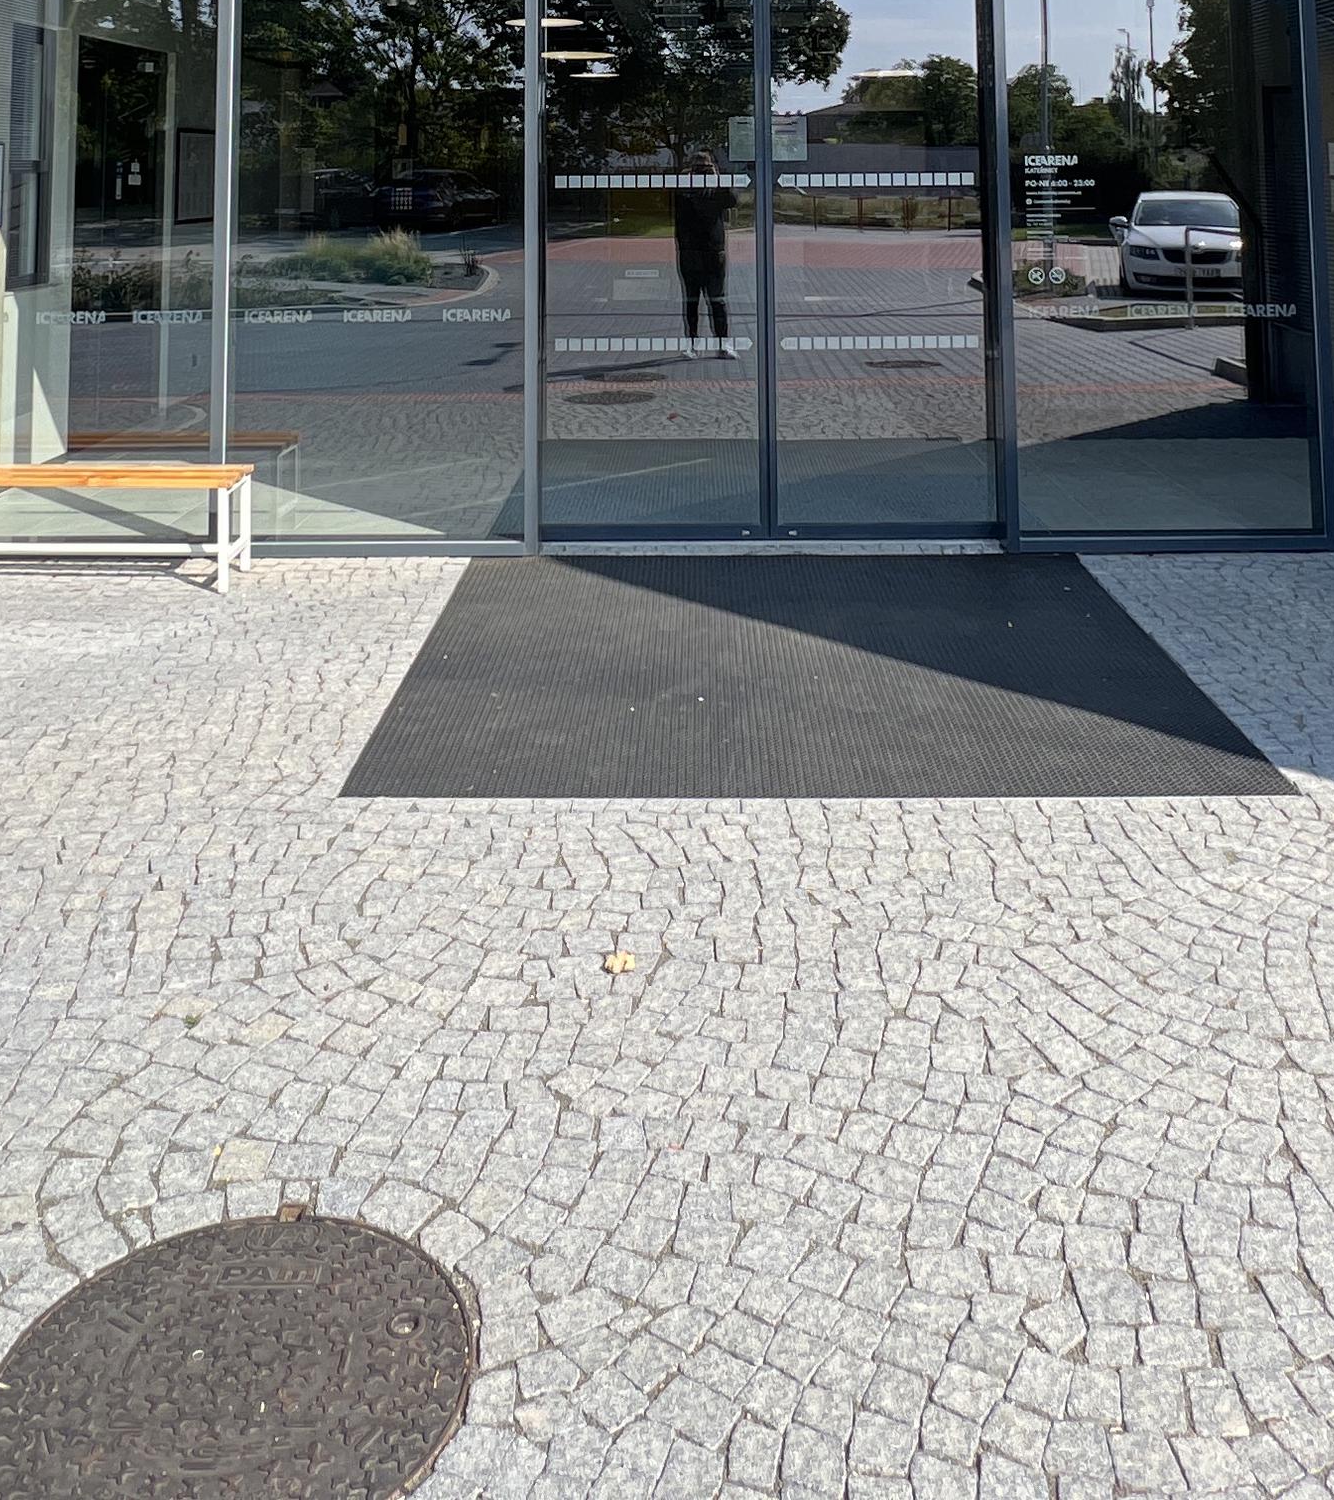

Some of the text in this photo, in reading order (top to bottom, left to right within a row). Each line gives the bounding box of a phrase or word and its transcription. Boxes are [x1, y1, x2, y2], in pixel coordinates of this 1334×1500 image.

[1024, 155, 1079, 166] ICEARENA
[36, 310, 107, 325] ICEARENA
[132, 310, 203, 325] ICEARENA
[244, 310, 313, 324] ICEARENA
[343, 309, 412, 323] ICEARENA
[442, 308, 511, 323] ICEARENA
